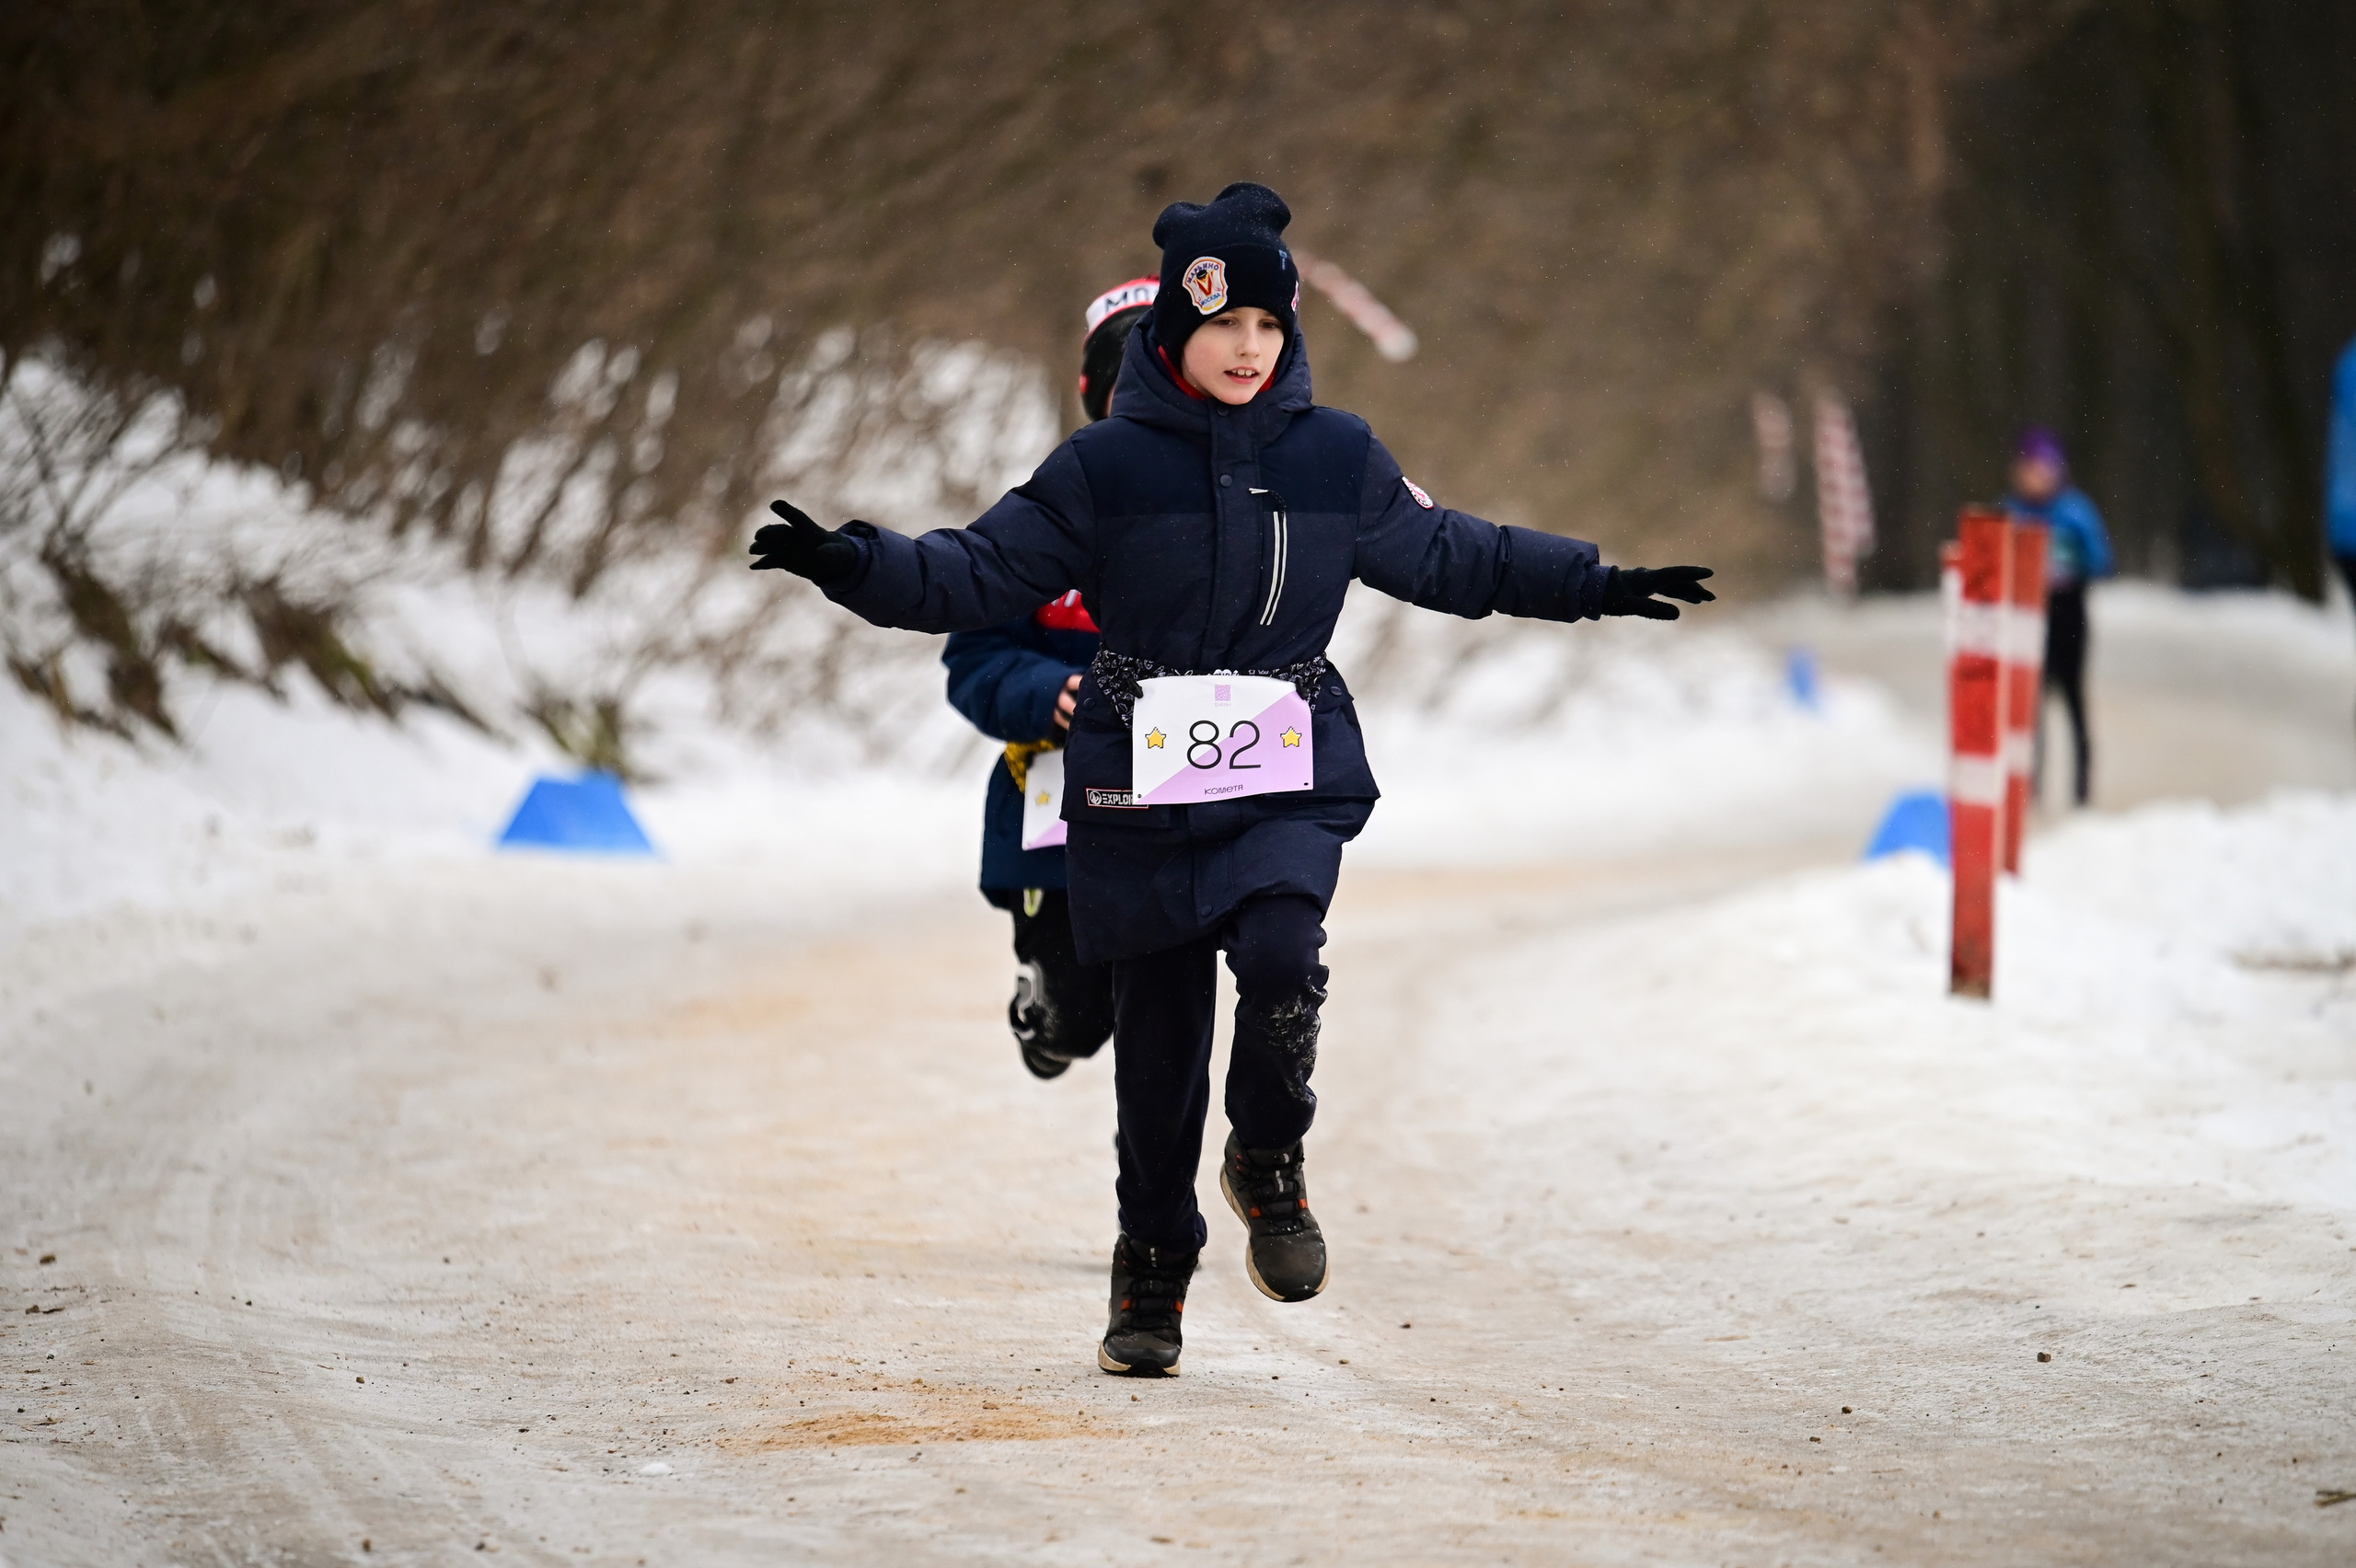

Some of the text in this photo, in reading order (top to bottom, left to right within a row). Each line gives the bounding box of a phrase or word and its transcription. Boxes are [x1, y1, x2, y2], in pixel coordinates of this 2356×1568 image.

[1187, 263, 1219, 283] МАРЬИНО
[1200, 292, 1221, 306] МОСКВА
[1187, 720, 1262, 769] 82
